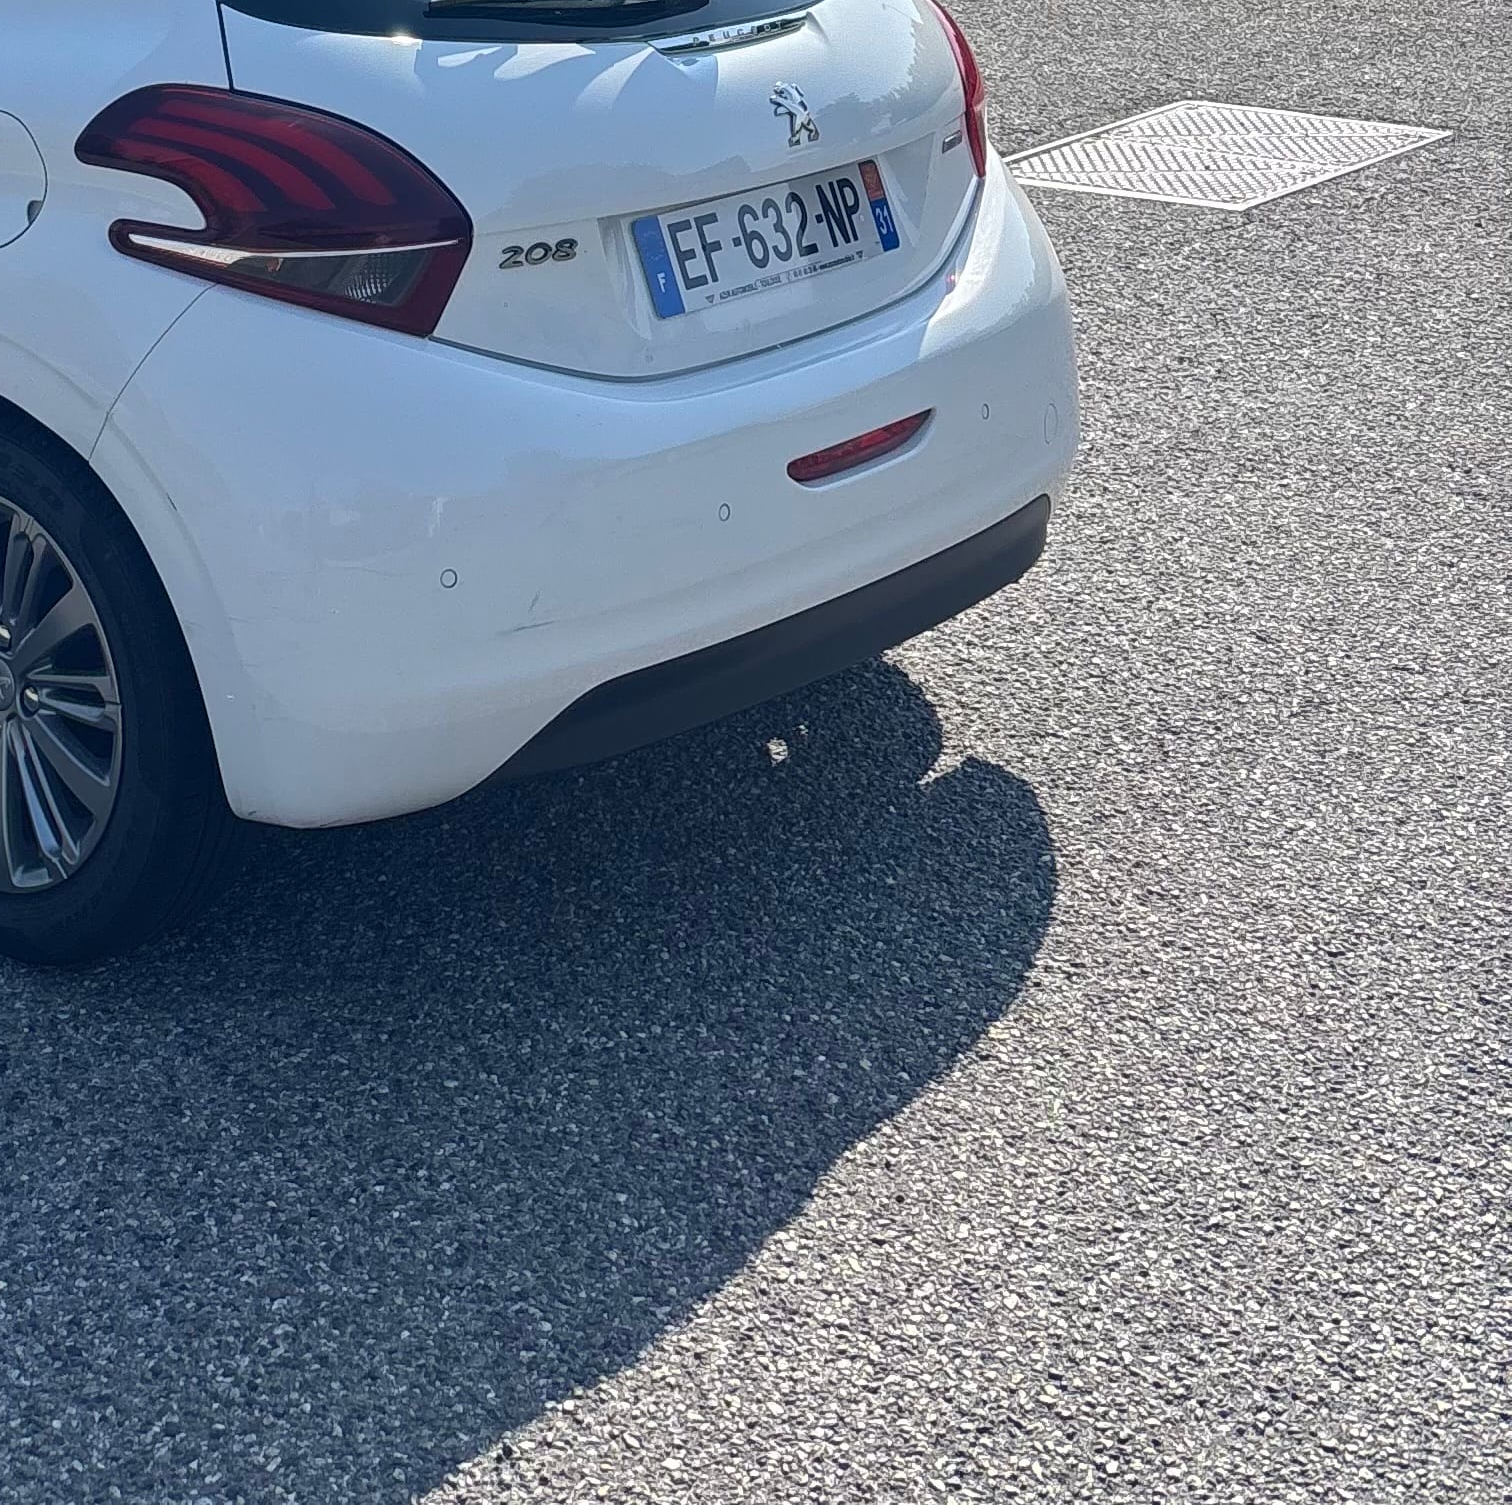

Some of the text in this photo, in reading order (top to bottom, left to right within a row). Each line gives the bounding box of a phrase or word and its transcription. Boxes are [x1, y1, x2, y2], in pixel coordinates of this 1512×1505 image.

[692, 20, 783, 47] PEUGEOT
[666, 177, 861, 291] EF-632-NP
[875, 204, 894, 235] 31
[498, 237, 579, 270] 208
[656, 272, 666, 293] F
